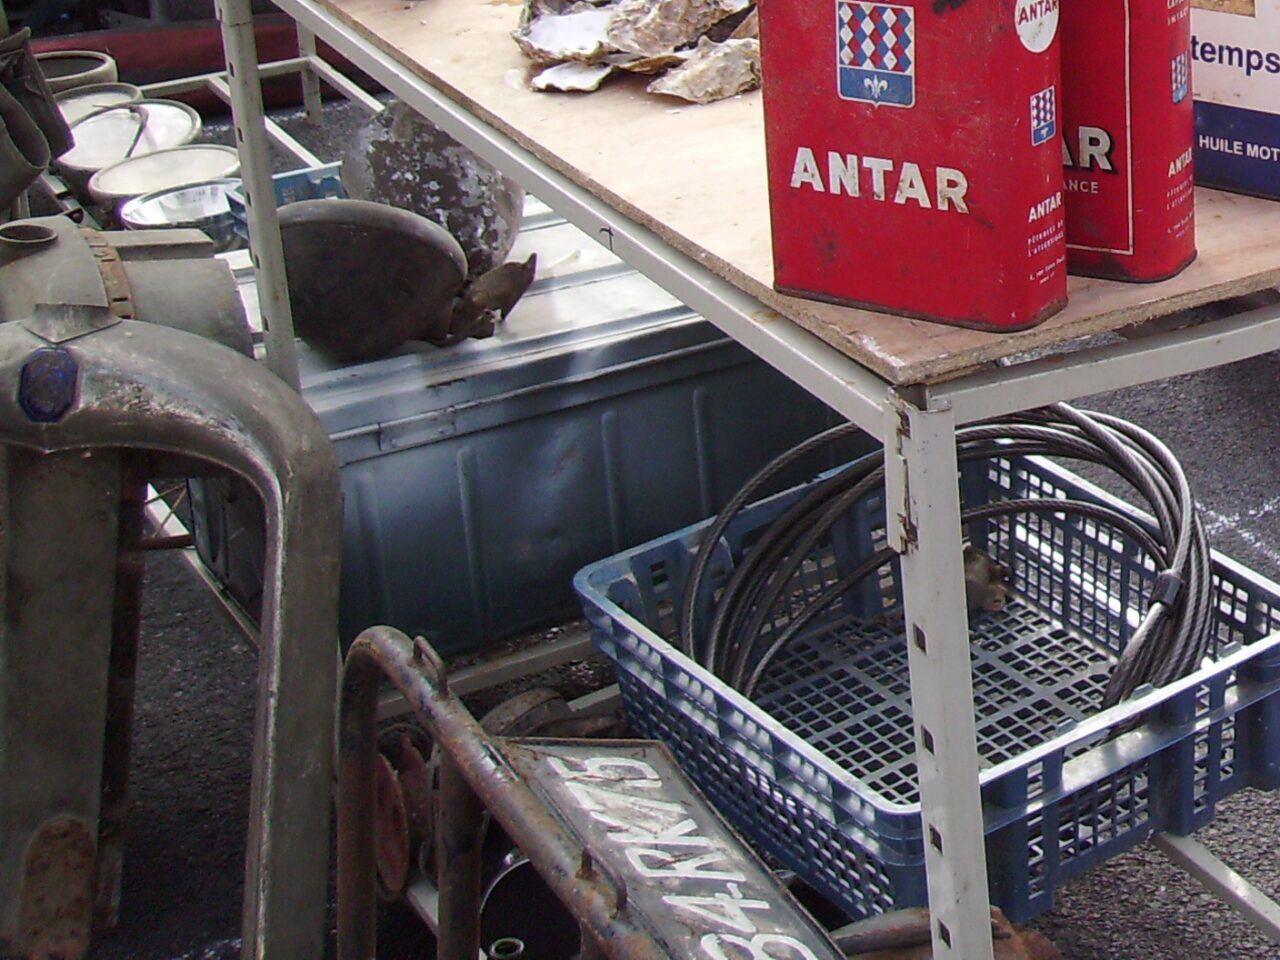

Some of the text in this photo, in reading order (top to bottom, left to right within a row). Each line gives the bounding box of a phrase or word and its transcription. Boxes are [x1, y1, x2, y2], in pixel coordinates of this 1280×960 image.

[1191, 35, 1280, 76] temps
[1199, 135, 1243, 155] HUILE
[791, 147, 969, 214] ANTAR
[1029, 191, 1062, 223] ANTAR
